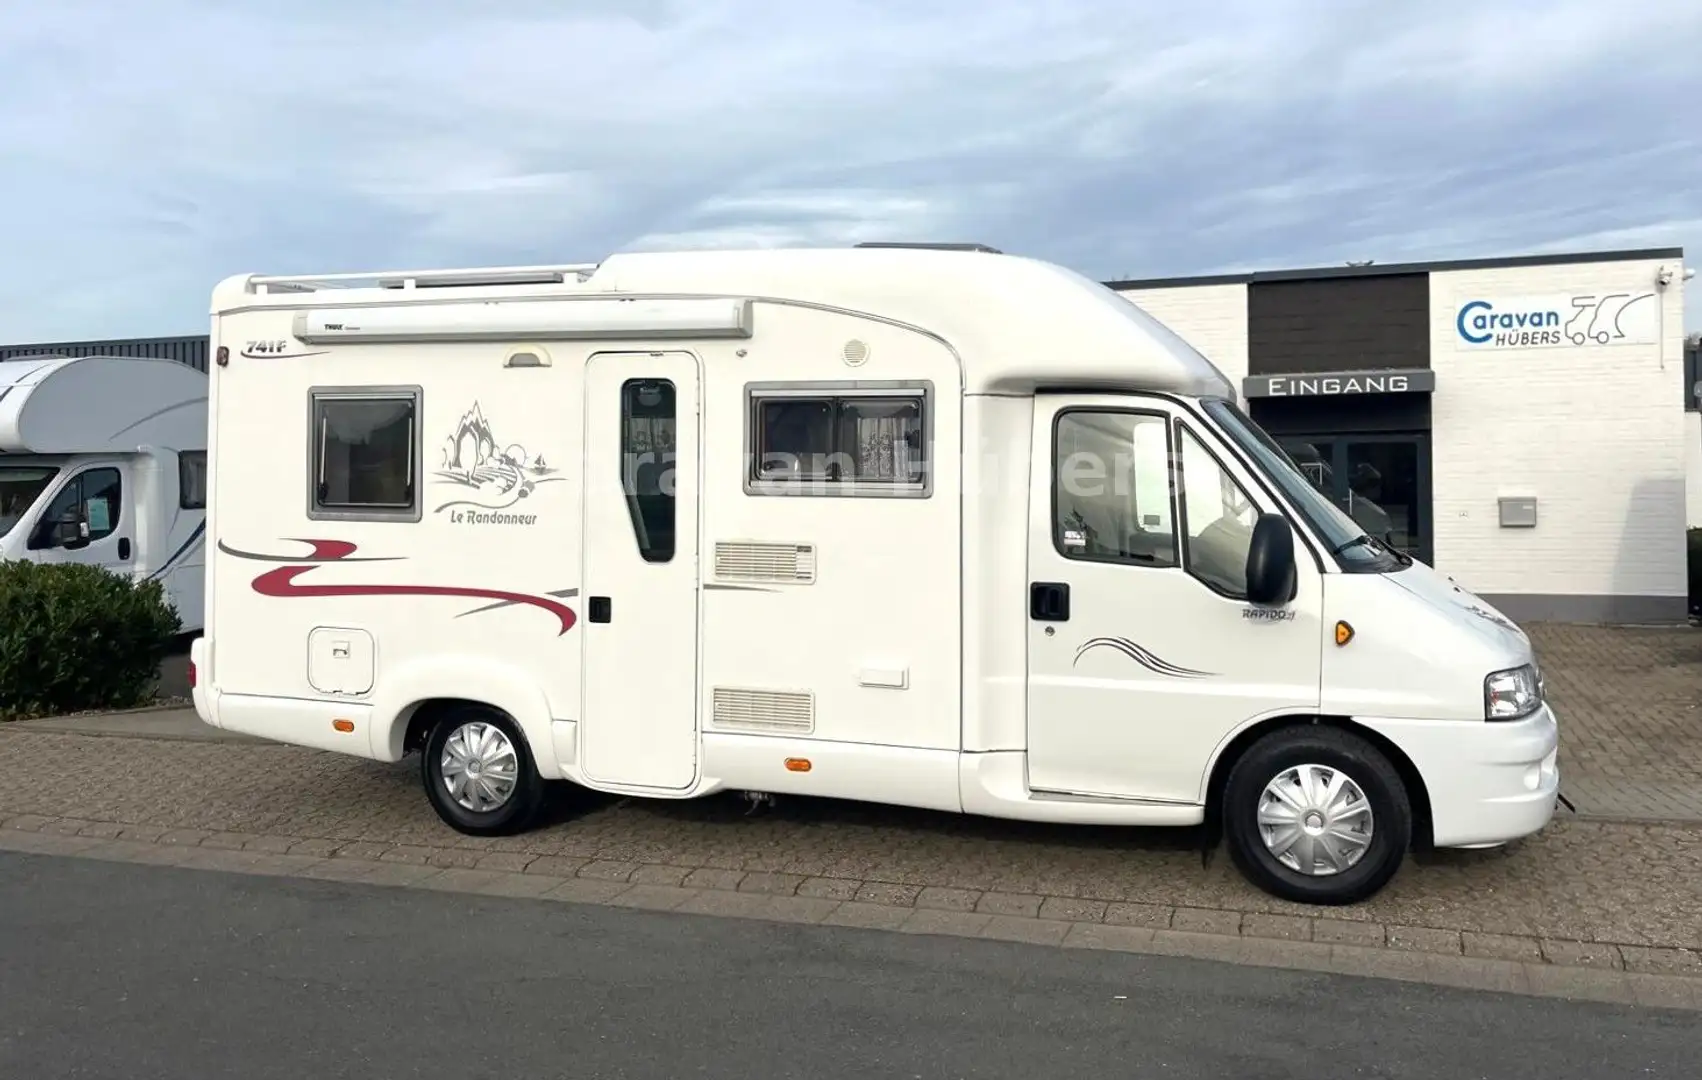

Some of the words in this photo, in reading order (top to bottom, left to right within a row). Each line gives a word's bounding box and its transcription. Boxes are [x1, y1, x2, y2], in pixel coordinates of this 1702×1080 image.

[1457, 301, 1559, 343] Caravan
[1495, 329, 1561, 346] HÜBERS
[246, 340, 287, 353] 741F
[451, 510, 463, 524] Le
[466, 510, 537, 525] Randonneur
